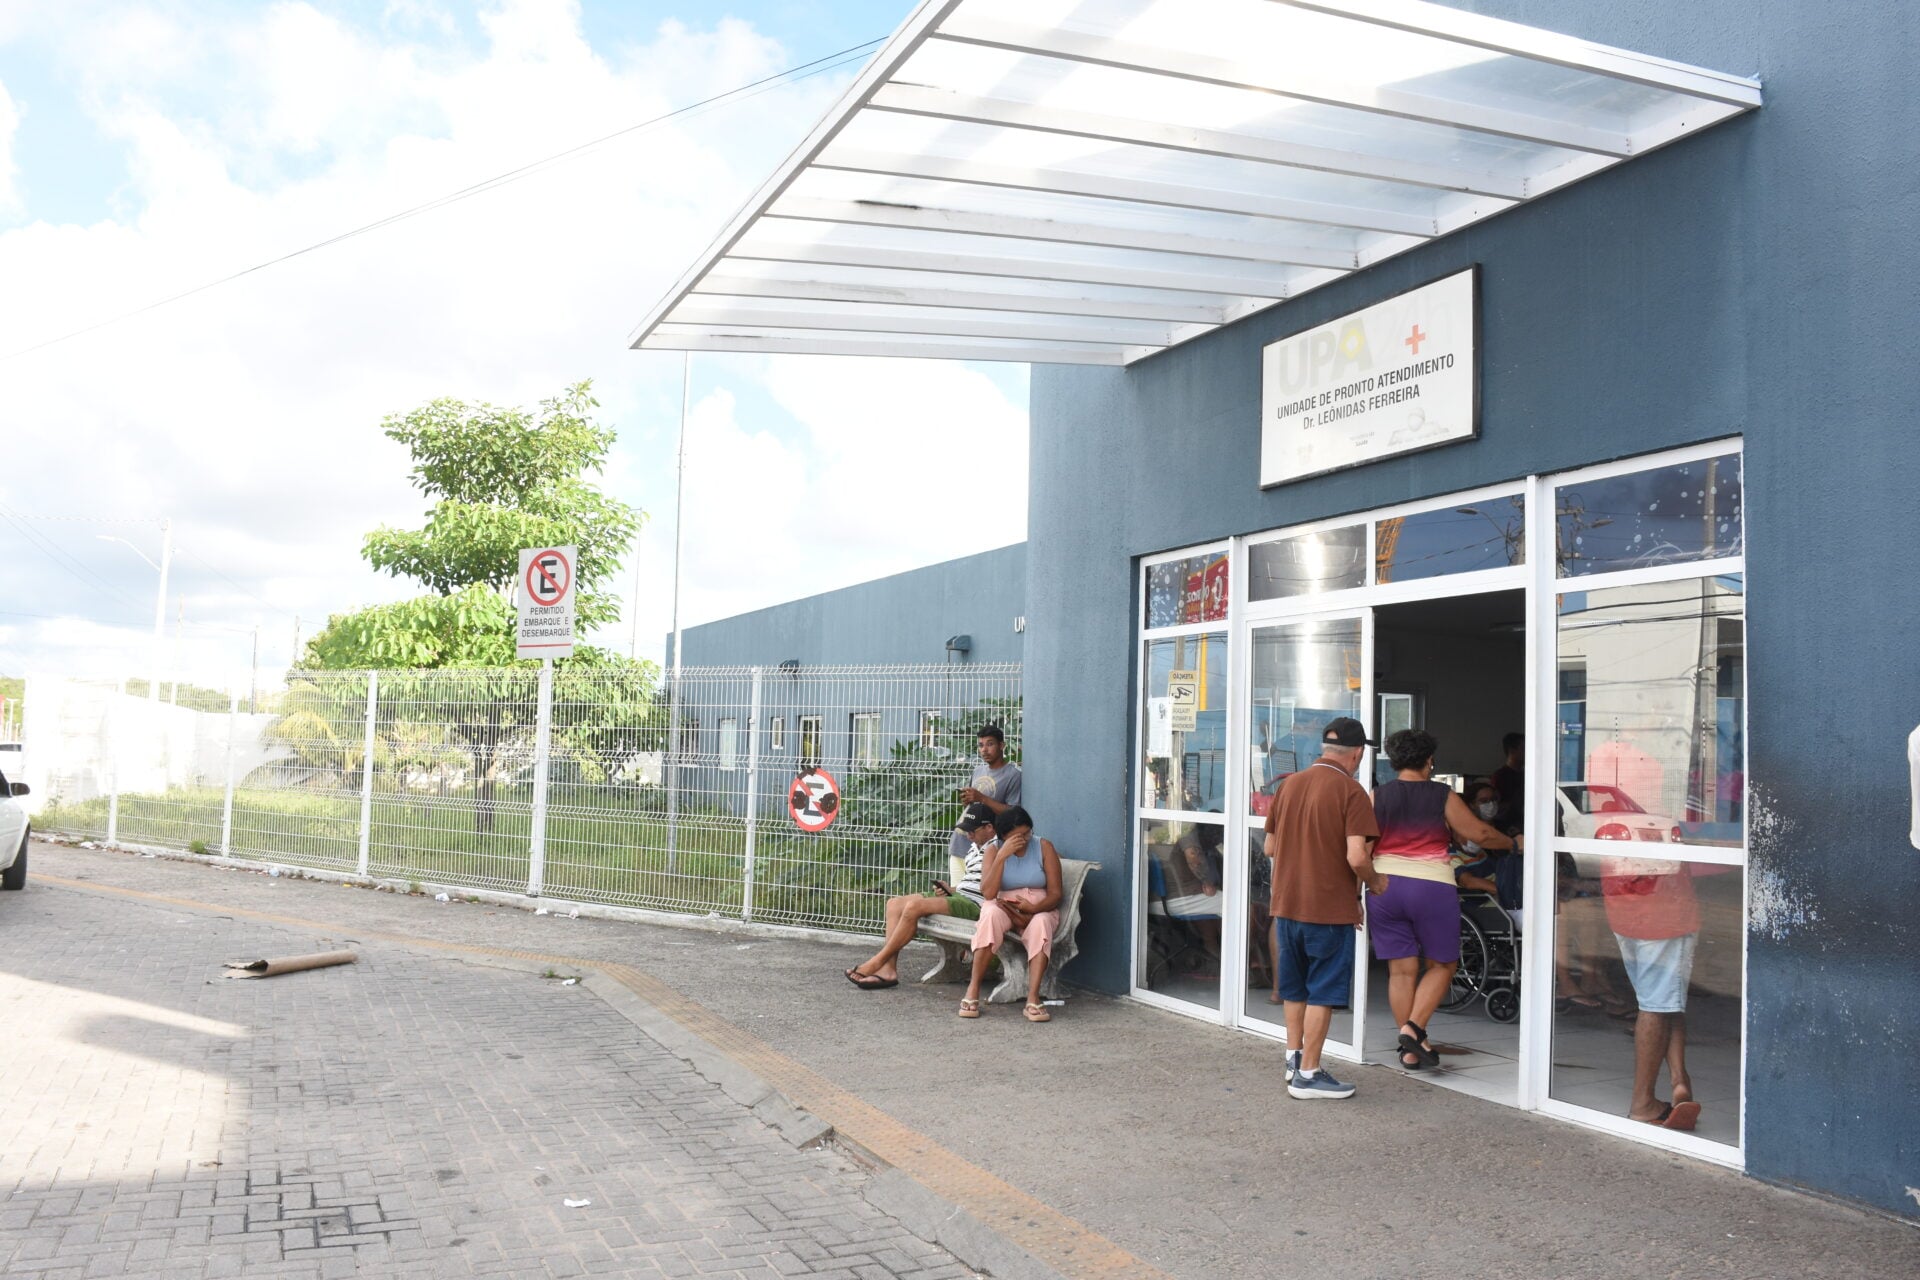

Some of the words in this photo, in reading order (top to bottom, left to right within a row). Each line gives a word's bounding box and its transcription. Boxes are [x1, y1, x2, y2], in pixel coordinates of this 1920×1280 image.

[1279, 317, 1375, 397] UPA
[1277, 396, 1317, 420] UNIDADE
[1319, 390, 1332, 407] DE
[1334, 377, 1375, 402] PRONTO
[1377, 353, 1454, 389] ATENDIMENTO
[1303, 416, 1316, 430] Dr.
[1369, 384, 1421, 411] FERREIRA
[524, 617, 561, 627] EMBARQUE
[564, 616, 569, 625] E
[530, 606, 565, 615] PERMITIDO
[521, 628, 570, 637] DESEMBARQUE
